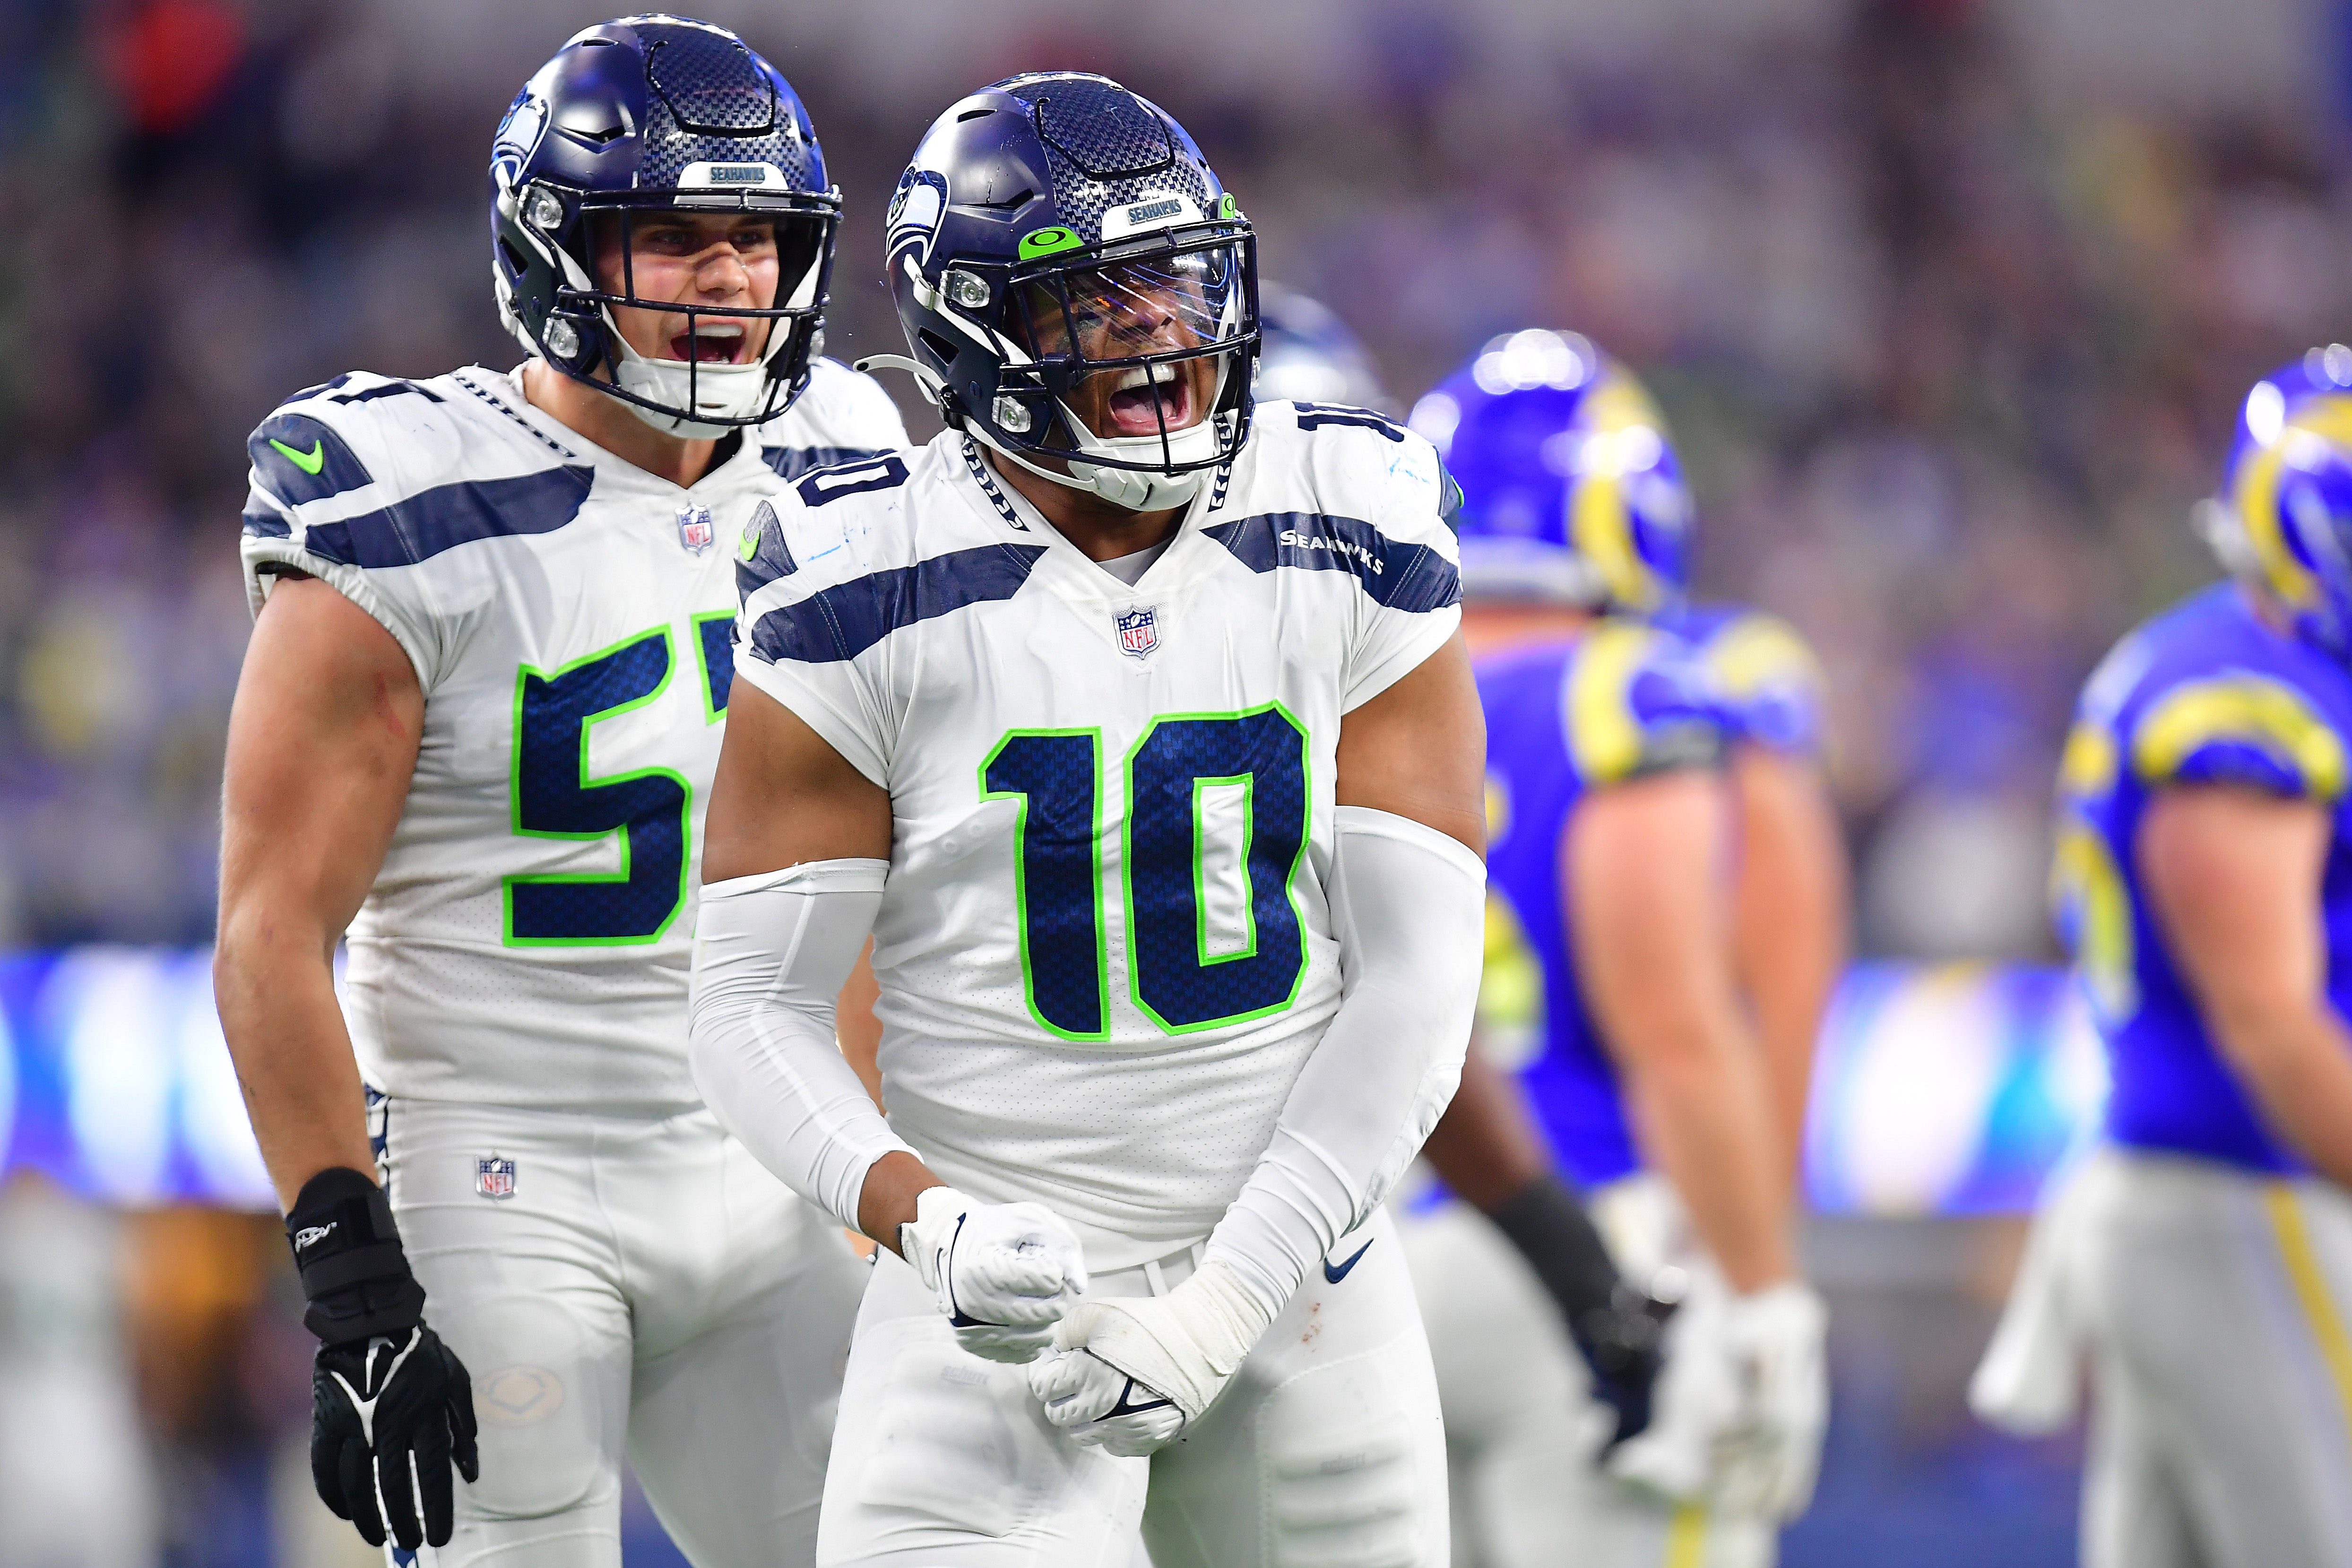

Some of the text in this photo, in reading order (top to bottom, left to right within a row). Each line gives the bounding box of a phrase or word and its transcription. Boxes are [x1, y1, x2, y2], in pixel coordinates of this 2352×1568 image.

[710, 166, 766, 184] SEAHAWKS
[1127, 199, 1182, 226] SEAHAWKS
[687, 525, 710, 545] NFL
[1123, 627, 1154, 649] NFL
[977, 698, 1311, 1041] 10
[484, 1174, 512, 1194] NFL
